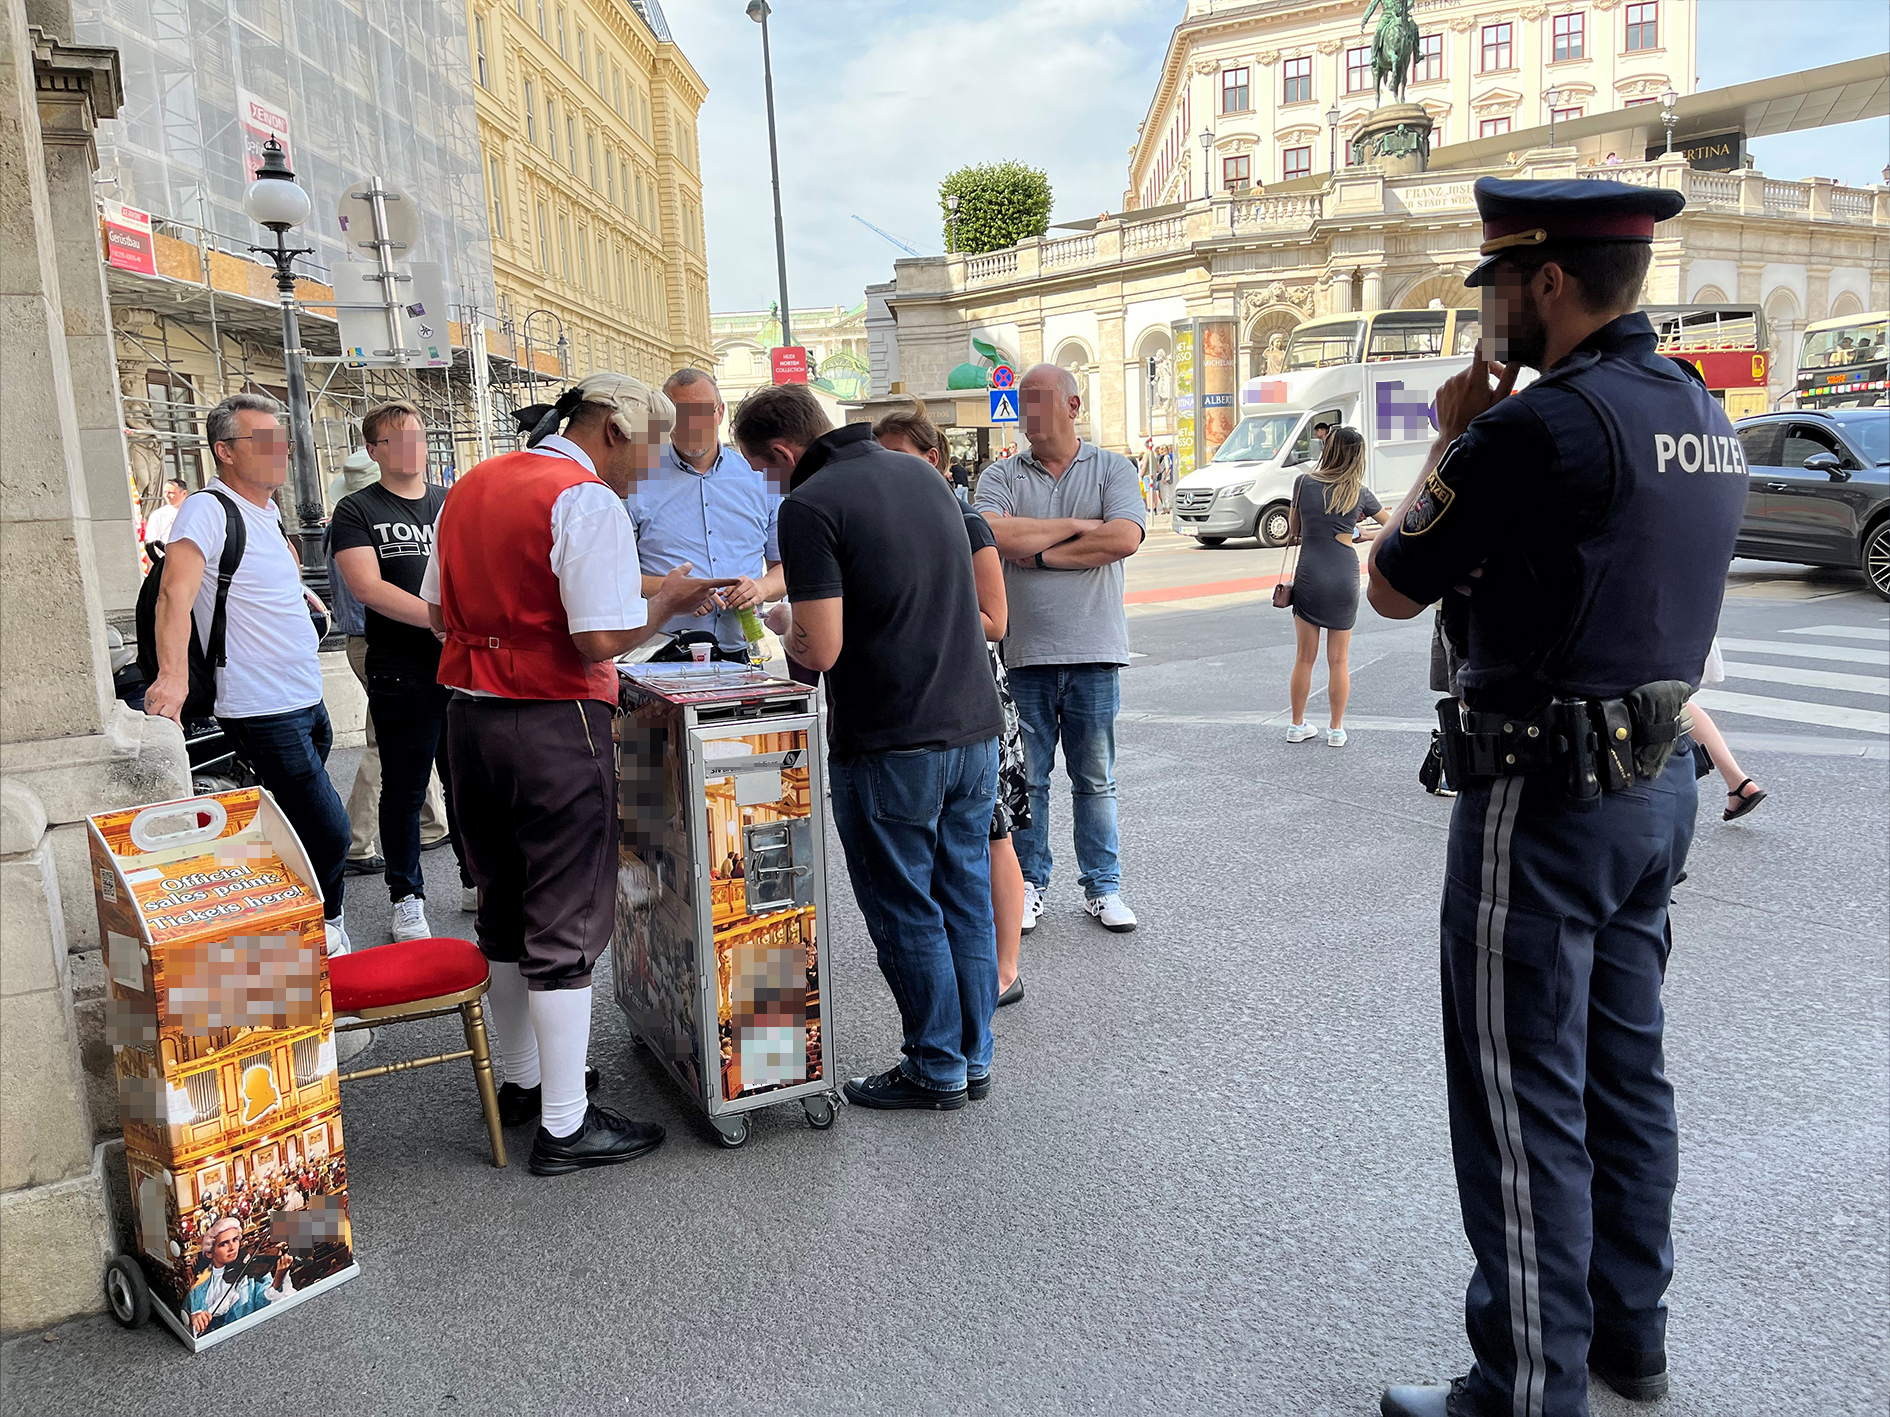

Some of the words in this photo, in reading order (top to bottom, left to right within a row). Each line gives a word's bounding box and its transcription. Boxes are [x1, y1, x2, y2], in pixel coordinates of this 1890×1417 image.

[1405, 187, 1442, 199] FRANZ
[1447, 184, 1475, 196] JOSE
[1417, 199, 1447, 208] STADT
[1451, 196, 1475, 204] WIEN
[109, 231, 140, 249] Gerüstbau
[1654, 434, 1747, 474] POLIZEI
[373, 523, 434, 543] TOM
[160, 866, 252, 891] Official
[144, 890, 208, 911] sales
[213, 873, 281, 898] point:
[148, 903, 242, 930] Tickets
[243, 884, 304, 908] here!
